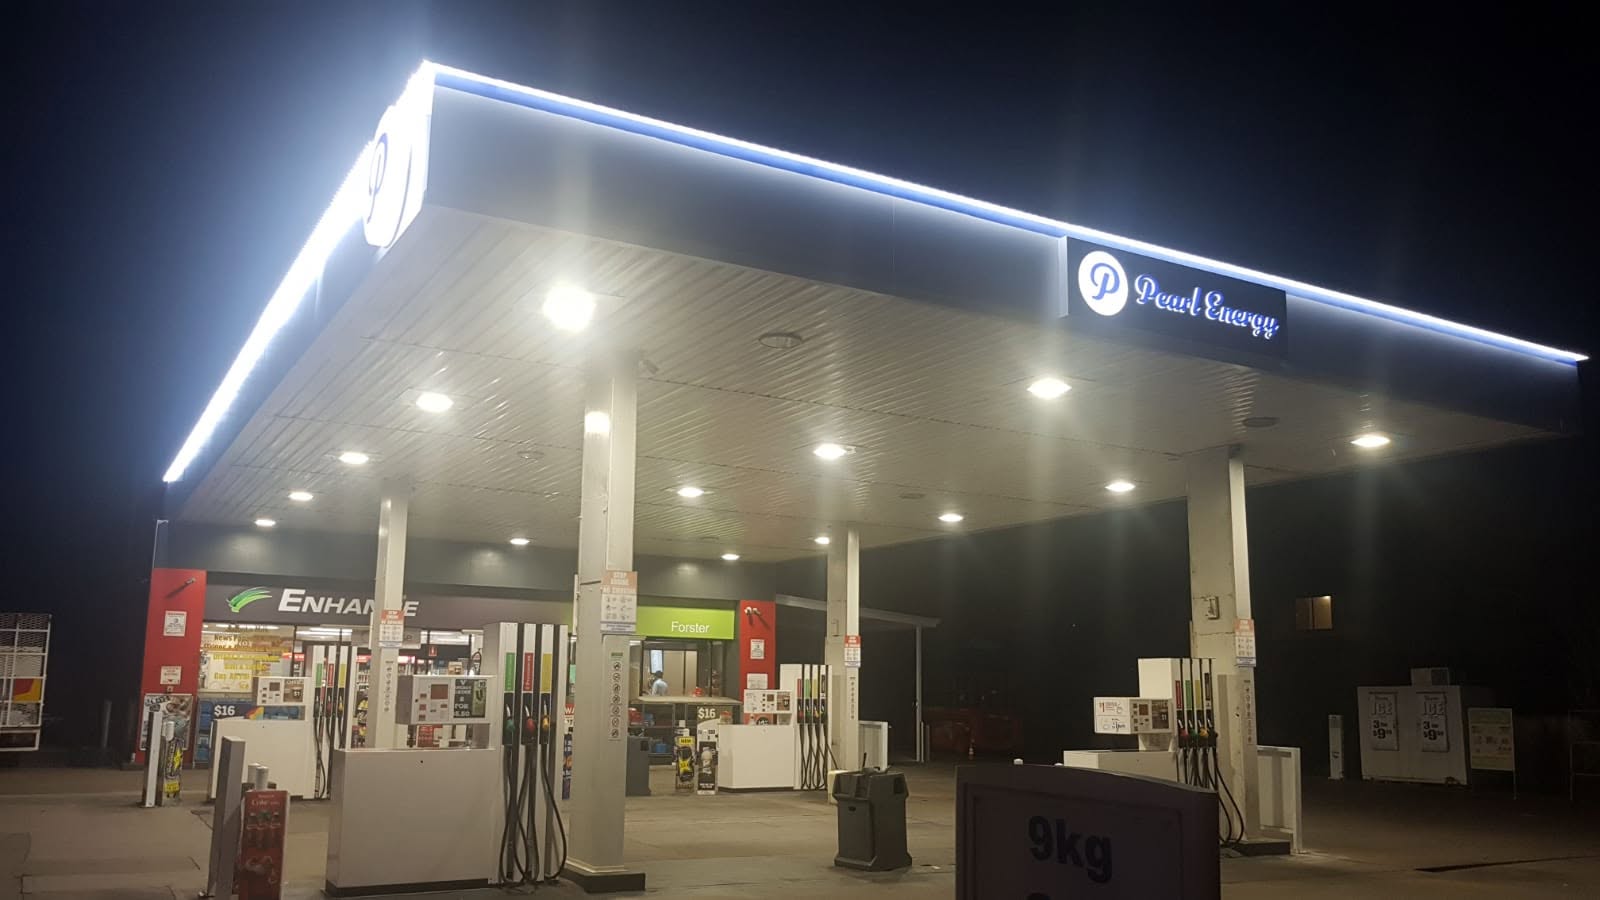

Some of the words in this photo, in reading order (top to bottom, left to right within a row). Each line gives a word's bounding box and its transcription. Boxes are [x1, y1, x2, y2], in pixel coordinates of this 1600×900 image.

[1090, 263, 1120, 300] P
[1134, 274, 1200, 316] Pearl
[1205, 290, 1280, 339] Energy
[278, 588, 419, 617] ENHANE
[671, 621, 709, 633] Forster
[214, 704, 236, 718] $16
[698, 707, 716, 719] $16
[1028, 815, 1113, 884] 9kg
